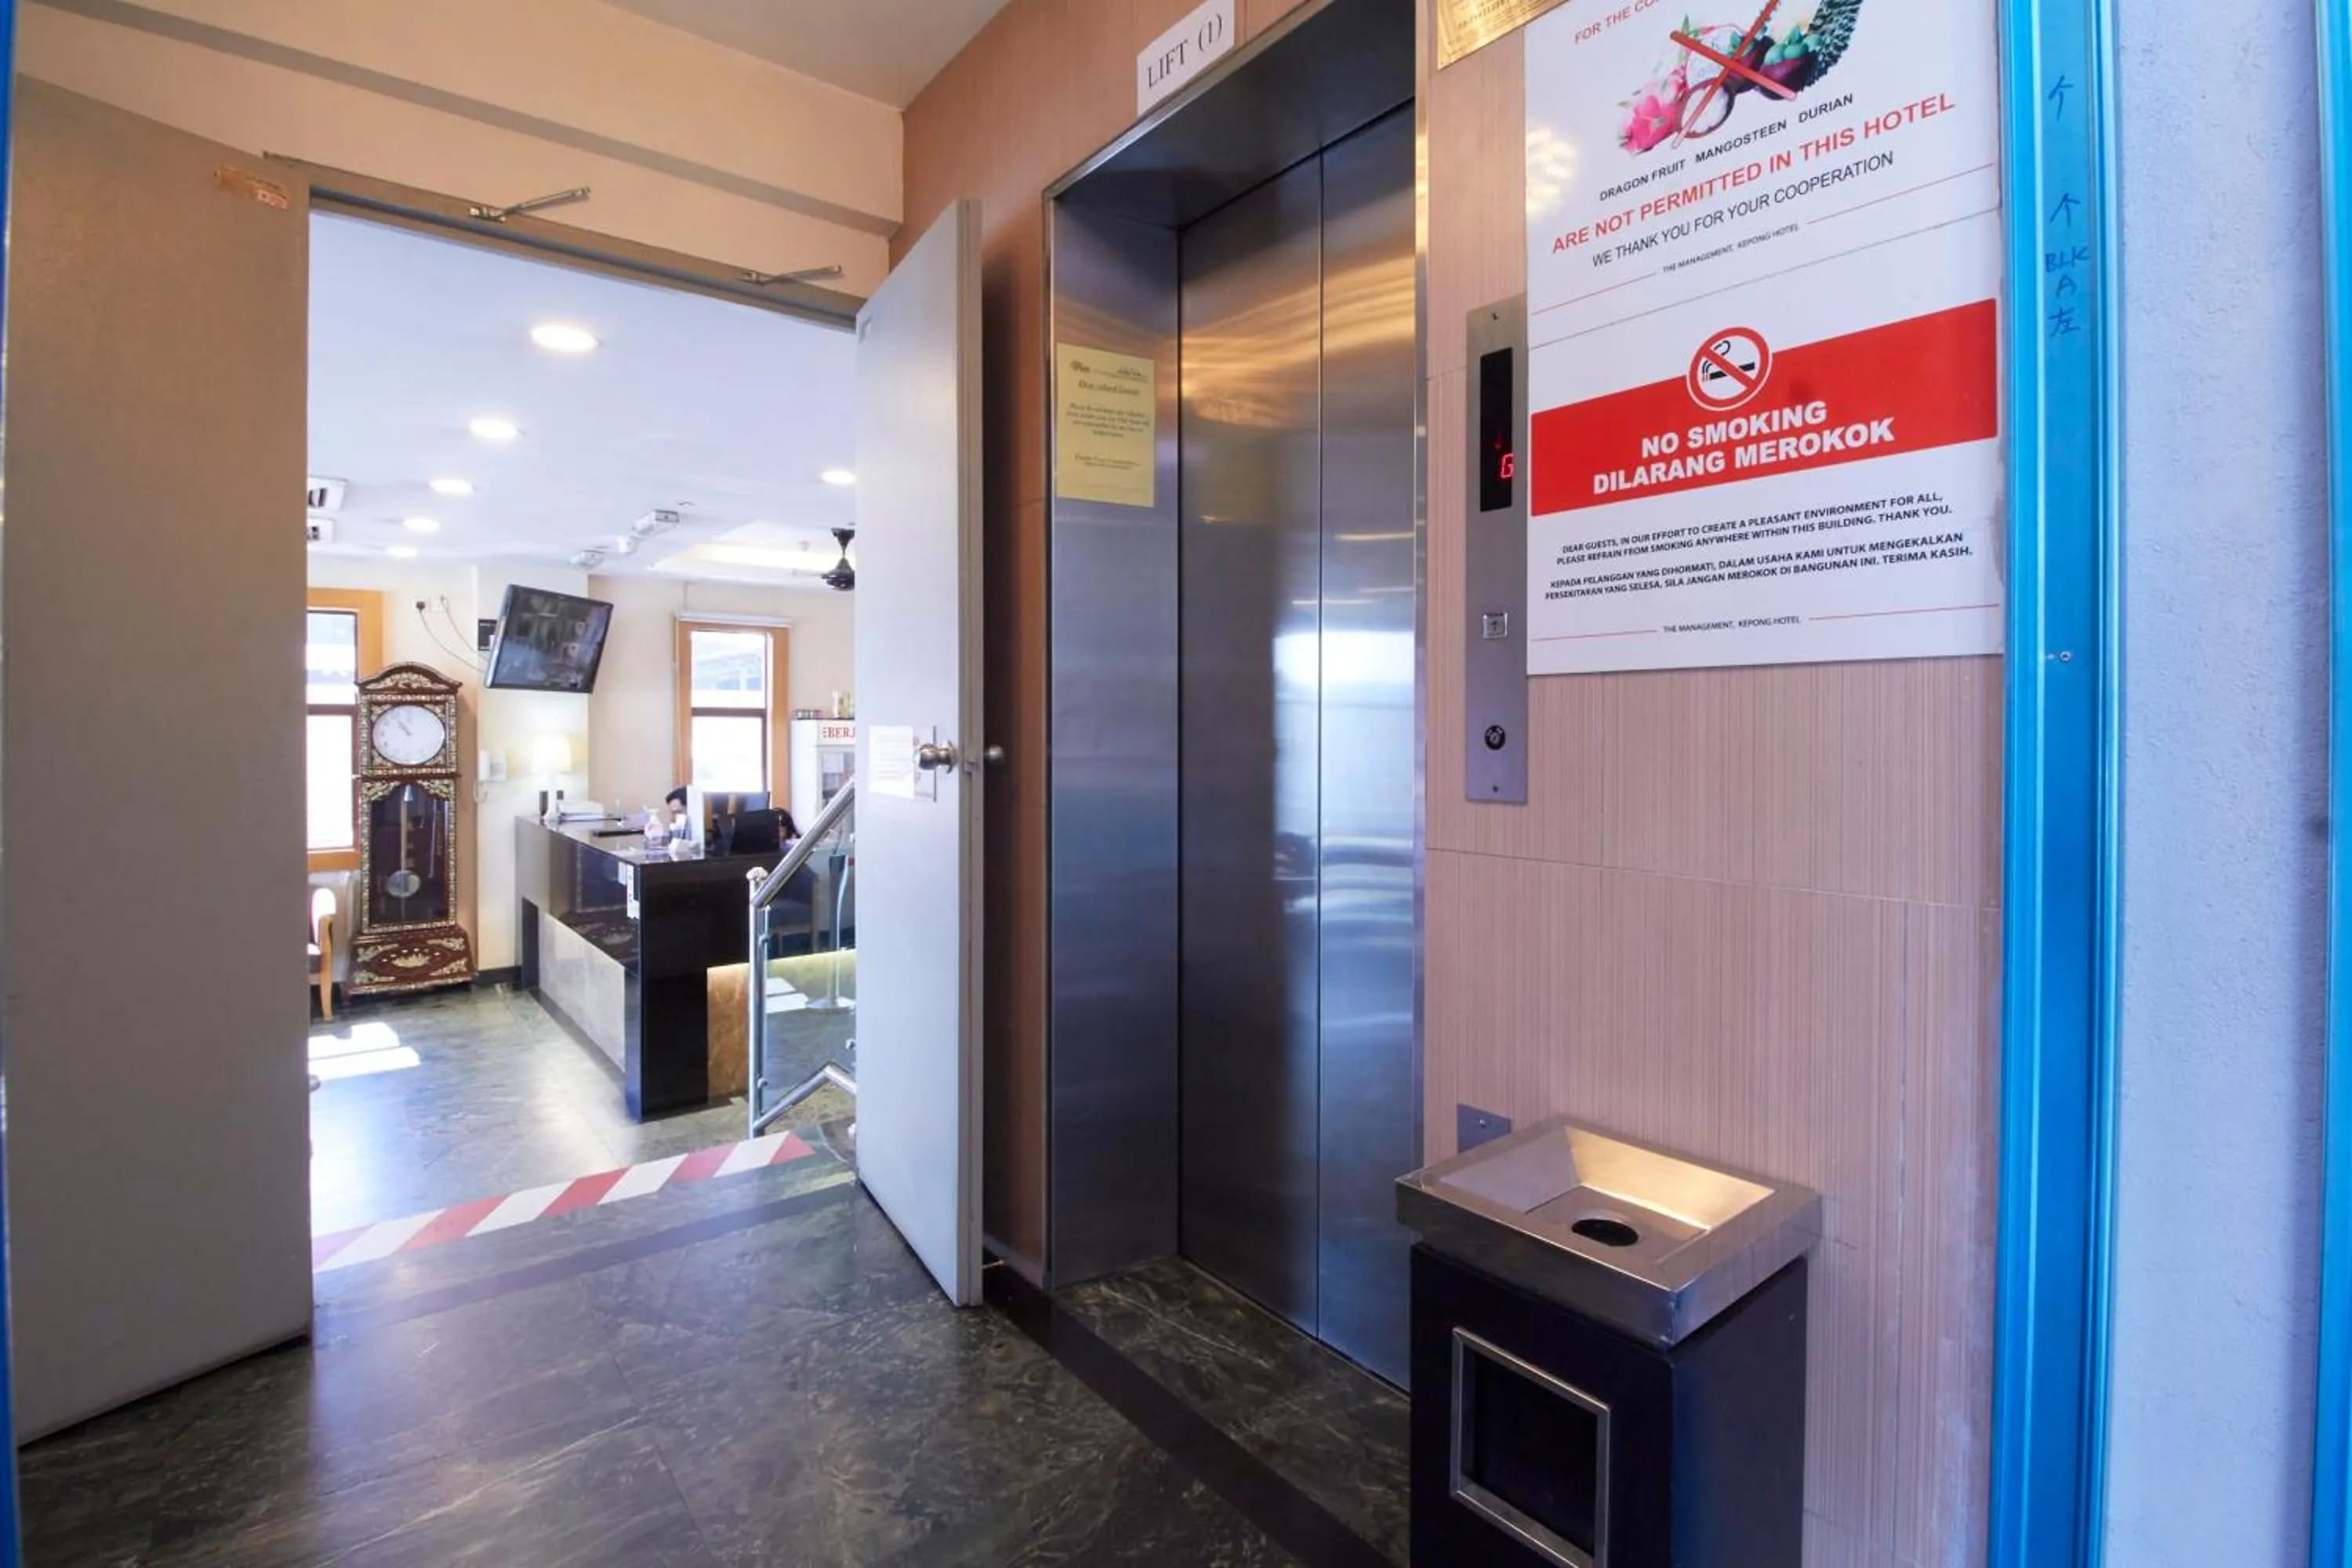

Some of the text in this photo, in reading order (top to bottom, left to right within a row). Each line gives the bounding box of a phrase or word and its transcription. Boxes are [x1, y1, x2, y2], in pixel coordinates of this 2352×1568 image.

[1574, 22, 1602, 45] FOR
[1605, 5, 1632, 27] THE
[1148, 38, 1189, 89] LIFT
[1552, 93, 1955, 254] ARE NOT PERMITTED IN THIS HOTEL
[1599, 93, 1853, 201] DRAGON FRUIT MANGOSTEEN DURIAN
[1592, 150, 1894, 268] WE THANK YOU FOR YOUR COOPERATION
[1663, 262, 1676, 274] THE
[1737, 230, 1771, 250] KEPONG
[1772, 223, 1799, 238] HOTEL
[2045, 245, 2089, 274] BLK
[2055, 274, 2078, 298] A
[1593, 416, 1895, 495] DILARANG MEROKOK
[1641, 400, 1828, 459] NO SMOKING
[1556, 504, 1952, 566] PLEASE REFRAIN FROM SMOKING ANYWHERE WITHIN THIS BUILDING. THANK YOU.
[1563, 542, 1584, 554] DEAR
[1584, 537, 1619, 550] GUESTS,
[1621, 536, 1631, 546] IN
[1632, 534, 1650, 544] OUR
[1652, 528, 1686, 542] EFFORT
[1687, 527, 1700, 536] TO
[1701, 520, 1737, 534] CREATE
[1739, 519, 1747, 528] A
[1748, 511, 1802, 527] PLEASANT
[1804, 499, 1888, 520] ENVIRONMENT
[1890, 495, 1915, 507] FOR
[1545, 546, 1973, 601] PERSEKITARAN YANG SELESA, SILA JANGAN MEROKOK DI BANGUNAN INI. TERIMA KASIH.
[1550, 532, 1964, 589] KEPADA PELANGGAN YANG DIHORMATI, DALAM USAHA KAMI UNTUK MENGEKALKAN
[1663, 625, 1677, 633] THE
[1738, 617, 1772, 628] KEPONG
[1773, 615, 1801, 626] HOTEL
